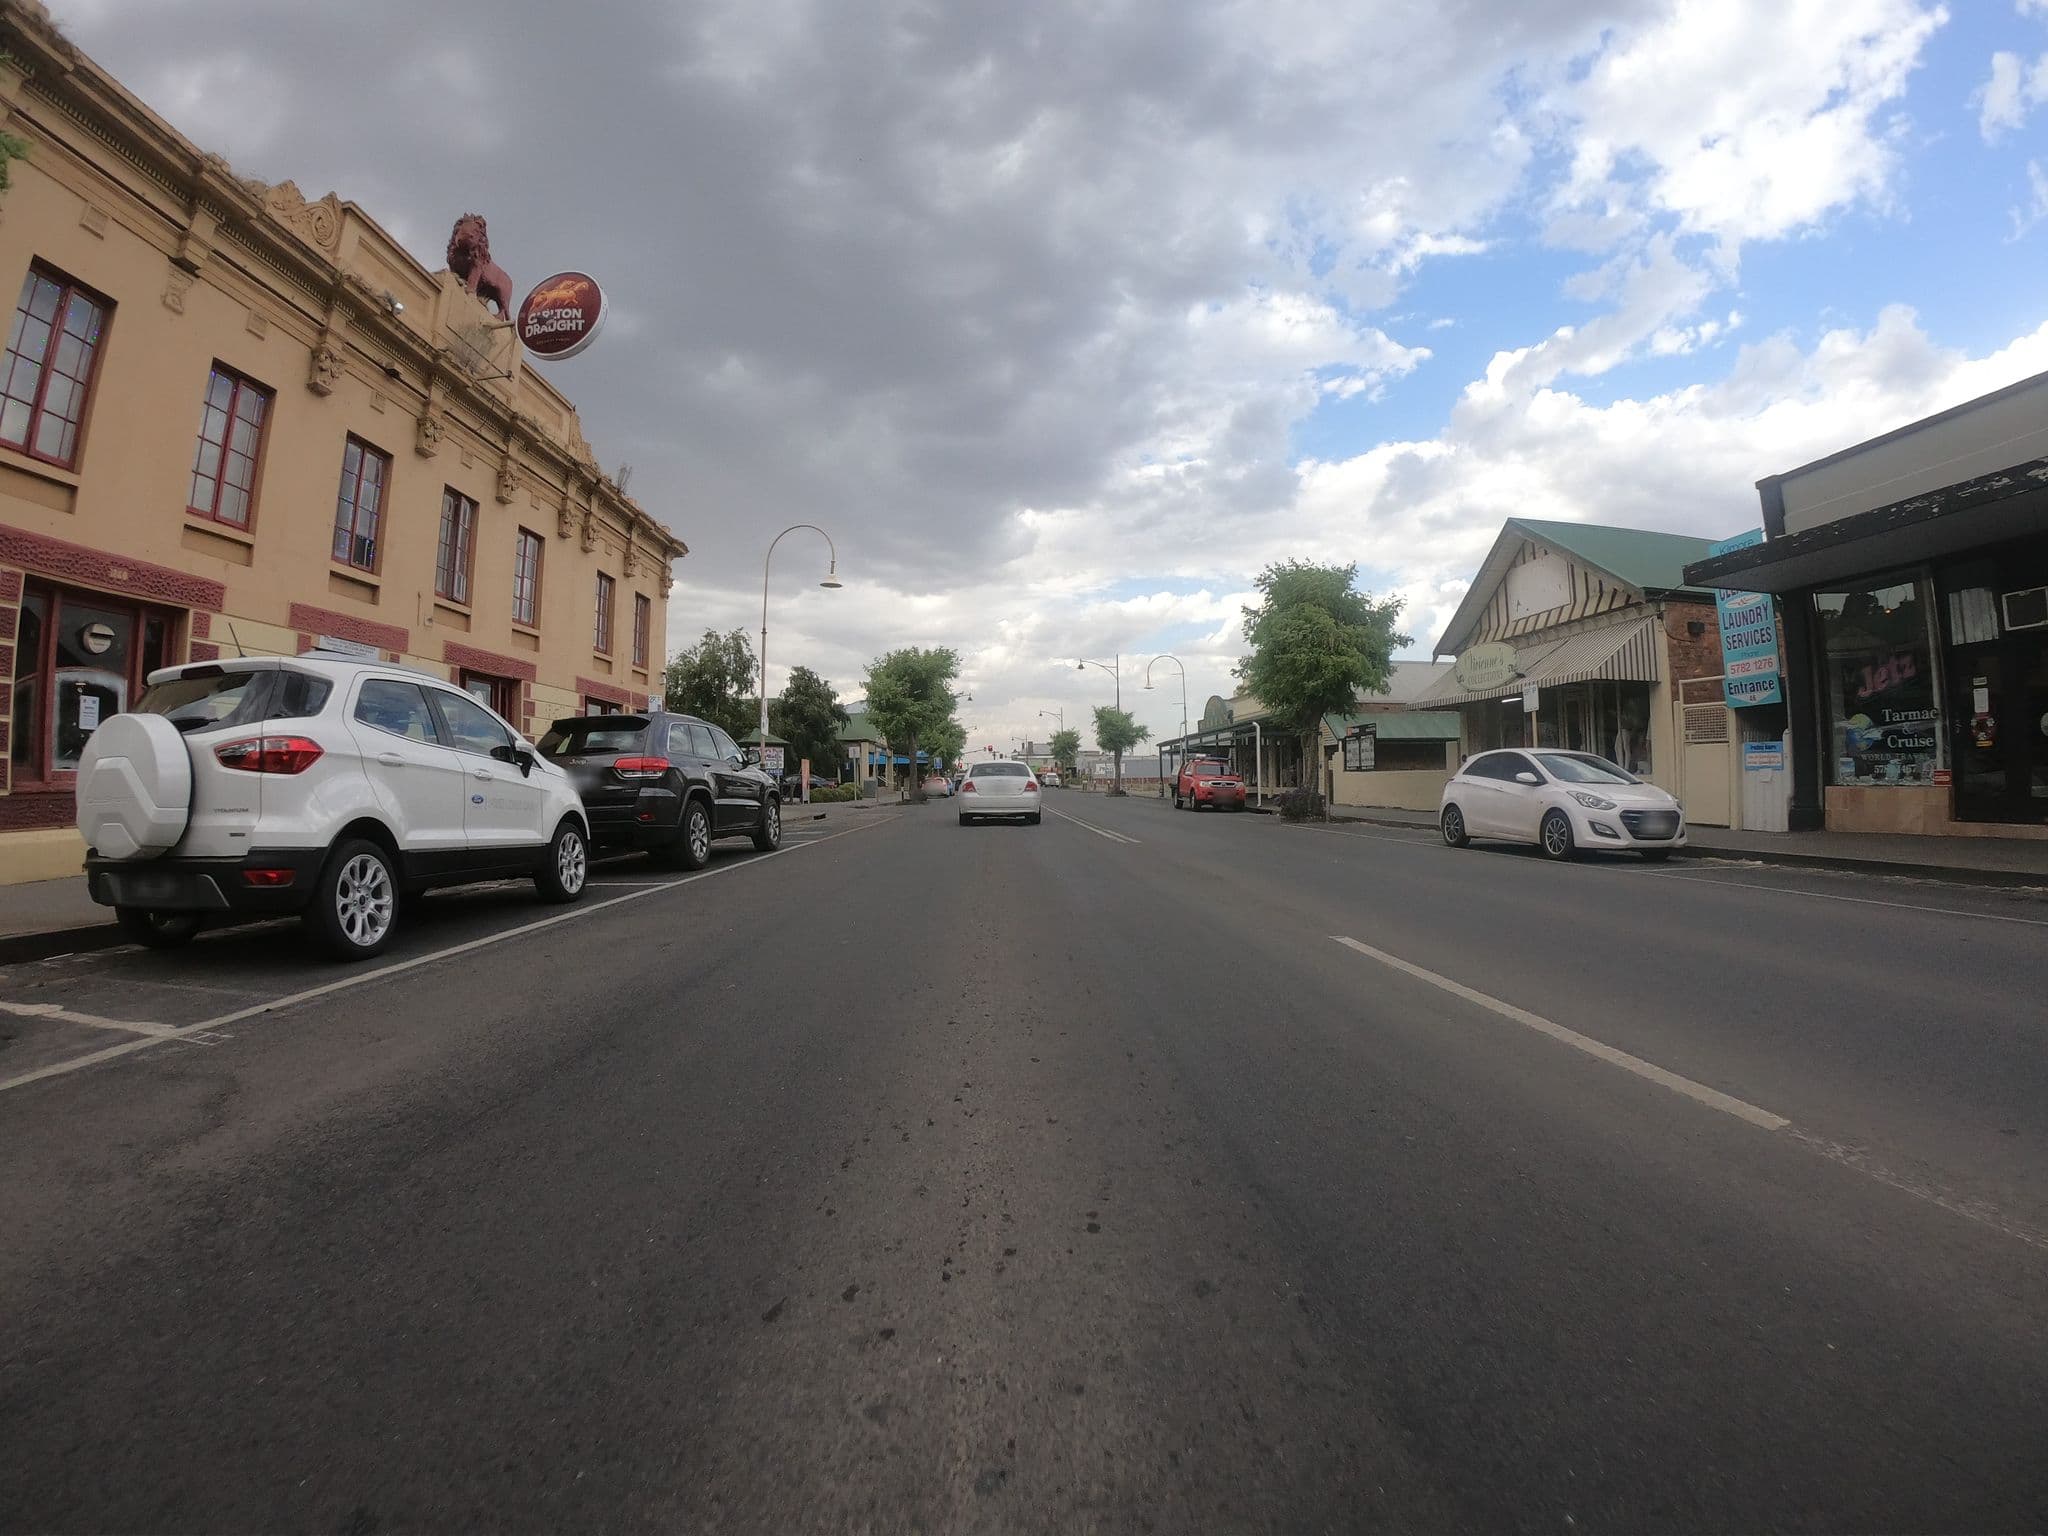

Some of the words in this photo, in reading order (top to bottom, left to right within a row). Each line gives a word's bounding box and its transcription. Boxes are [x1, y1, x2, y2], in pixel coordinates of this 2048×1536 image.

[528, 308, 582, 325] CRTON
[525, 319, 585, 338] DRAUGHT
[1722, 601, 1769, 631] LAUNDRY
[1725, 626, 1772, 651] SERVICES
[1731, 662, 1751, 674] 5782
[1754, 657, 1774, 670] 1276
[1728, 679, 1775, 695] Entrance
[1882, 707, 1938, 721] Tarmac
[1902, 722, 1913, 734] &
[1887, 734, 1935, 748] Cruise
[1861, 753, 1891, 761] WORLD
